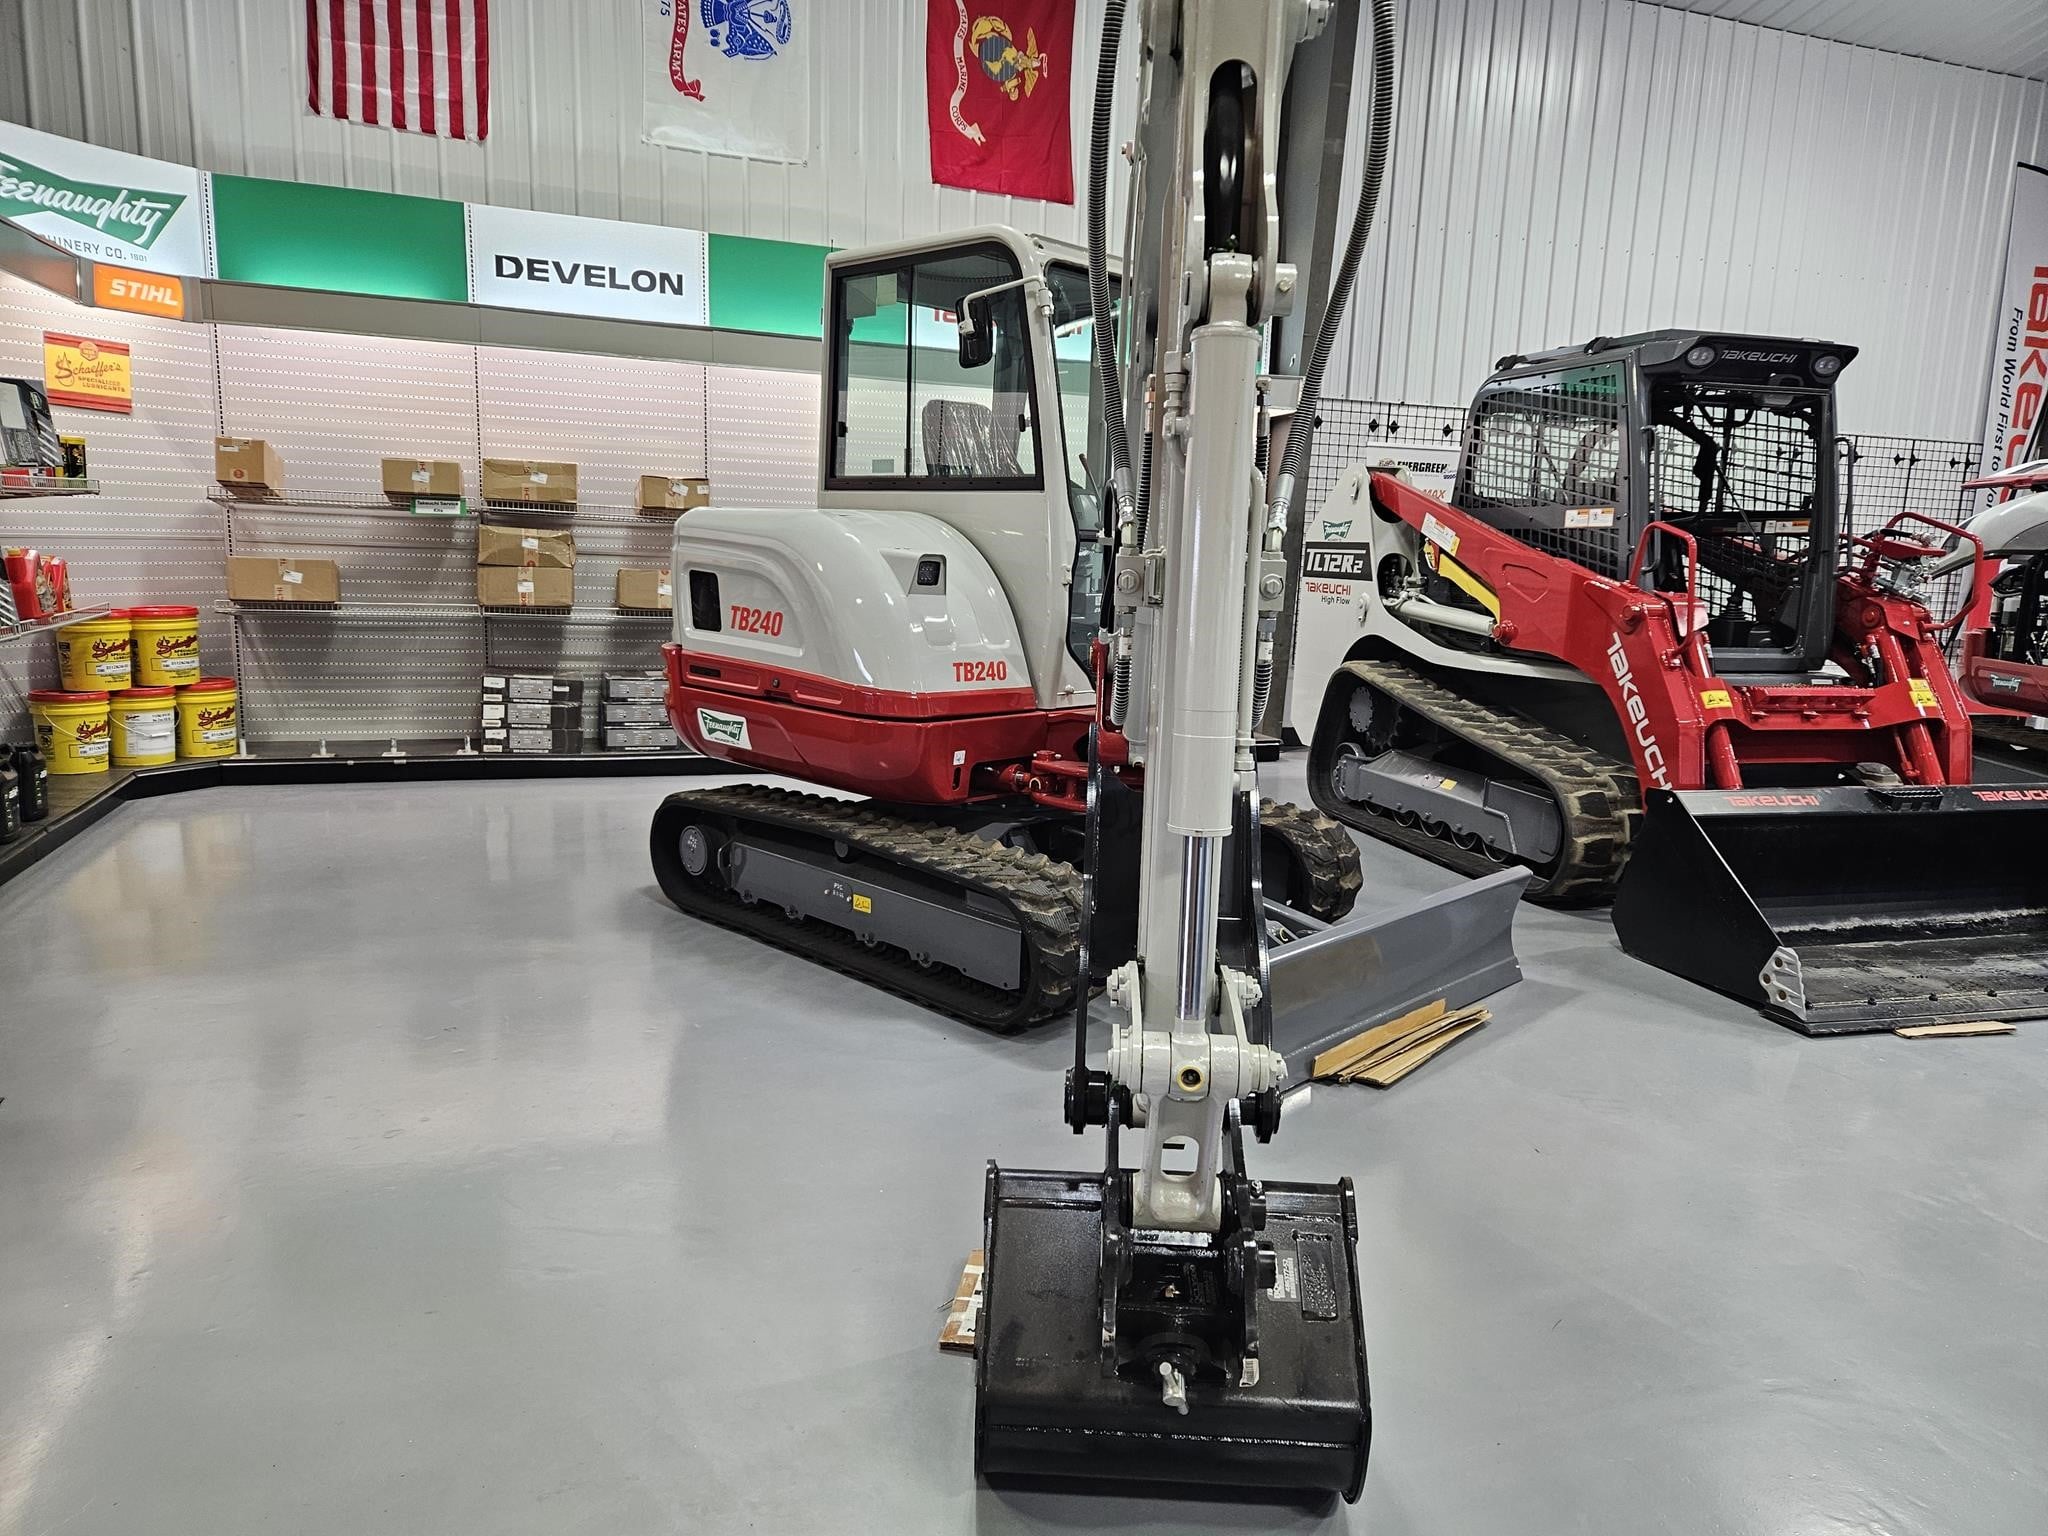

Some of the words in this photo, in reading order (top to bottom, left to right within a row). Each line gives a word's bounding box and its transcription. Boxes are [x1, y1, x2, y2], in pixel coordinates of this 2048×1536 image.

[677, 0, 687, 34] ATES
[957, 8, 967, 40] STATES
[671, 38, 684, 82] ARMY
[956, 56, 967, 92] MARINE
[951, 105, 968, 132] CORPS
[105, 246, 127, 261] CO.
[495, 254, 684, 296] DEVELON
[109, 278, 179, 306] STIHL
[2006, 307, 2024, 352] From
[2000, 358, 2017, 409] World
[1994, 412, 2009, 451] First
[1991, 455, 2002, 472] to
[1306, 548, 1367, 574] TL12R2
[1321, 595, 1335, 605] High
[1336, 596, 1351, 605] Flow
[731, 605, 784, 637] TB240
[952, 661, 1007, 683] TB240
[1606, 631, 1673, 791] TAKEUCH
